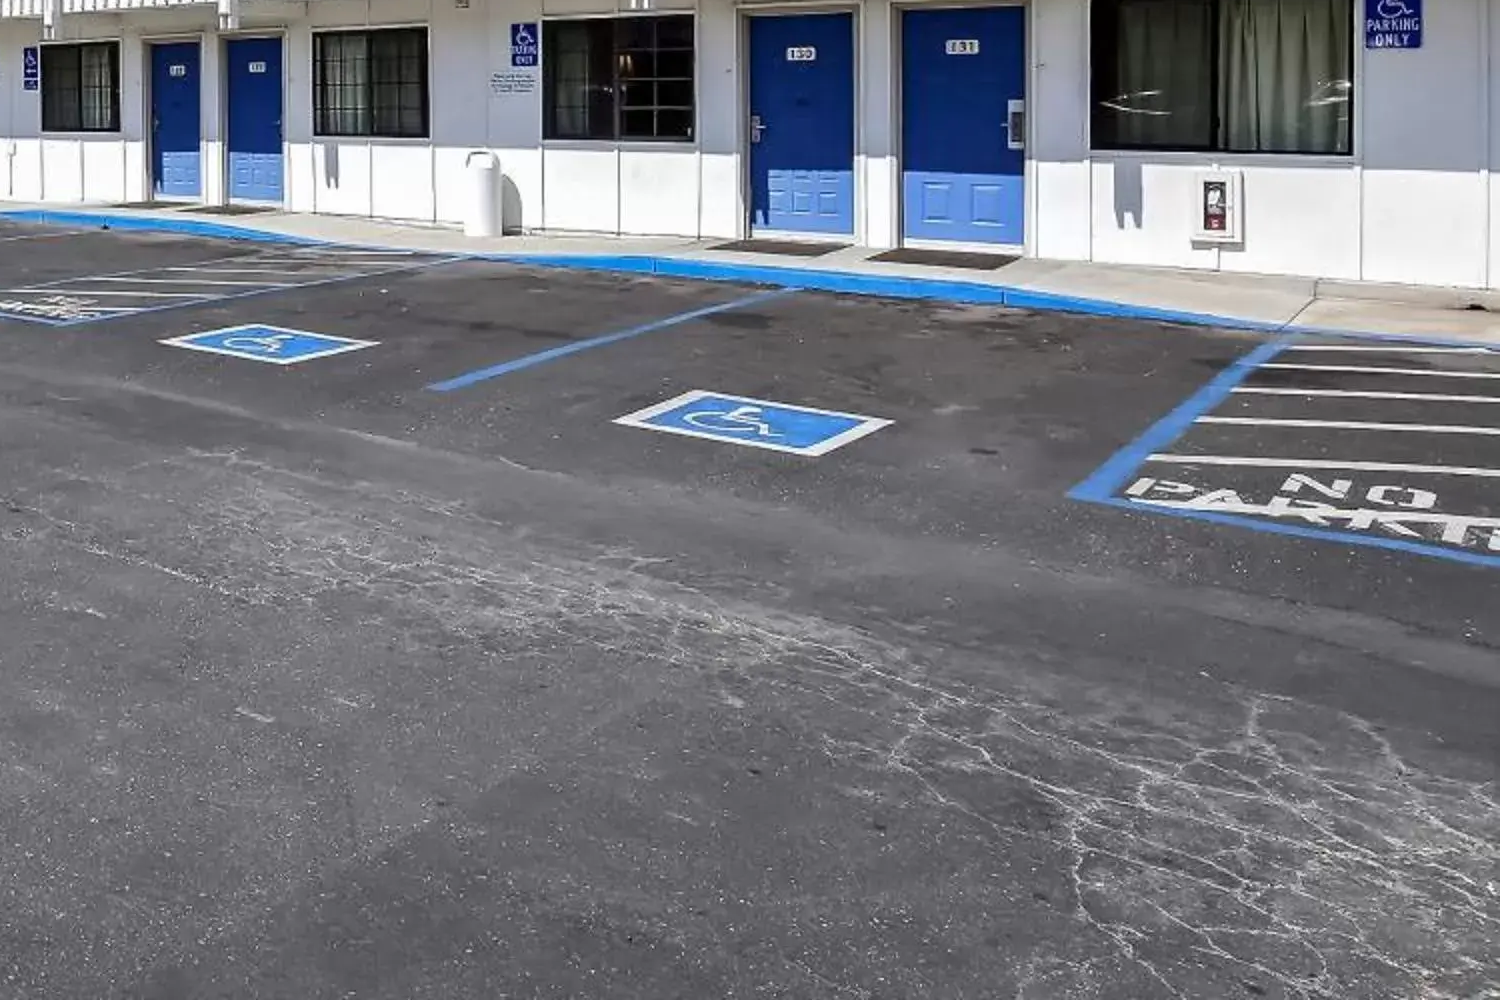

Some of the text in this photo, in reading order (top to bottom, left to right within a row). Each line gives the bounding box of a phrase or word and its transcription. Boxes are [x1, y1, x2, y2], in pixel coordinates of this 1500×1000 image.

[1367, 17, 1419, 31] PARKING
[1375, 33, 1410, 46] ONLY
[949, 40, 977, 54] 131
[1280, 473, 1437, 509] NO
[1125, 477, 1500, 551] PARKI
